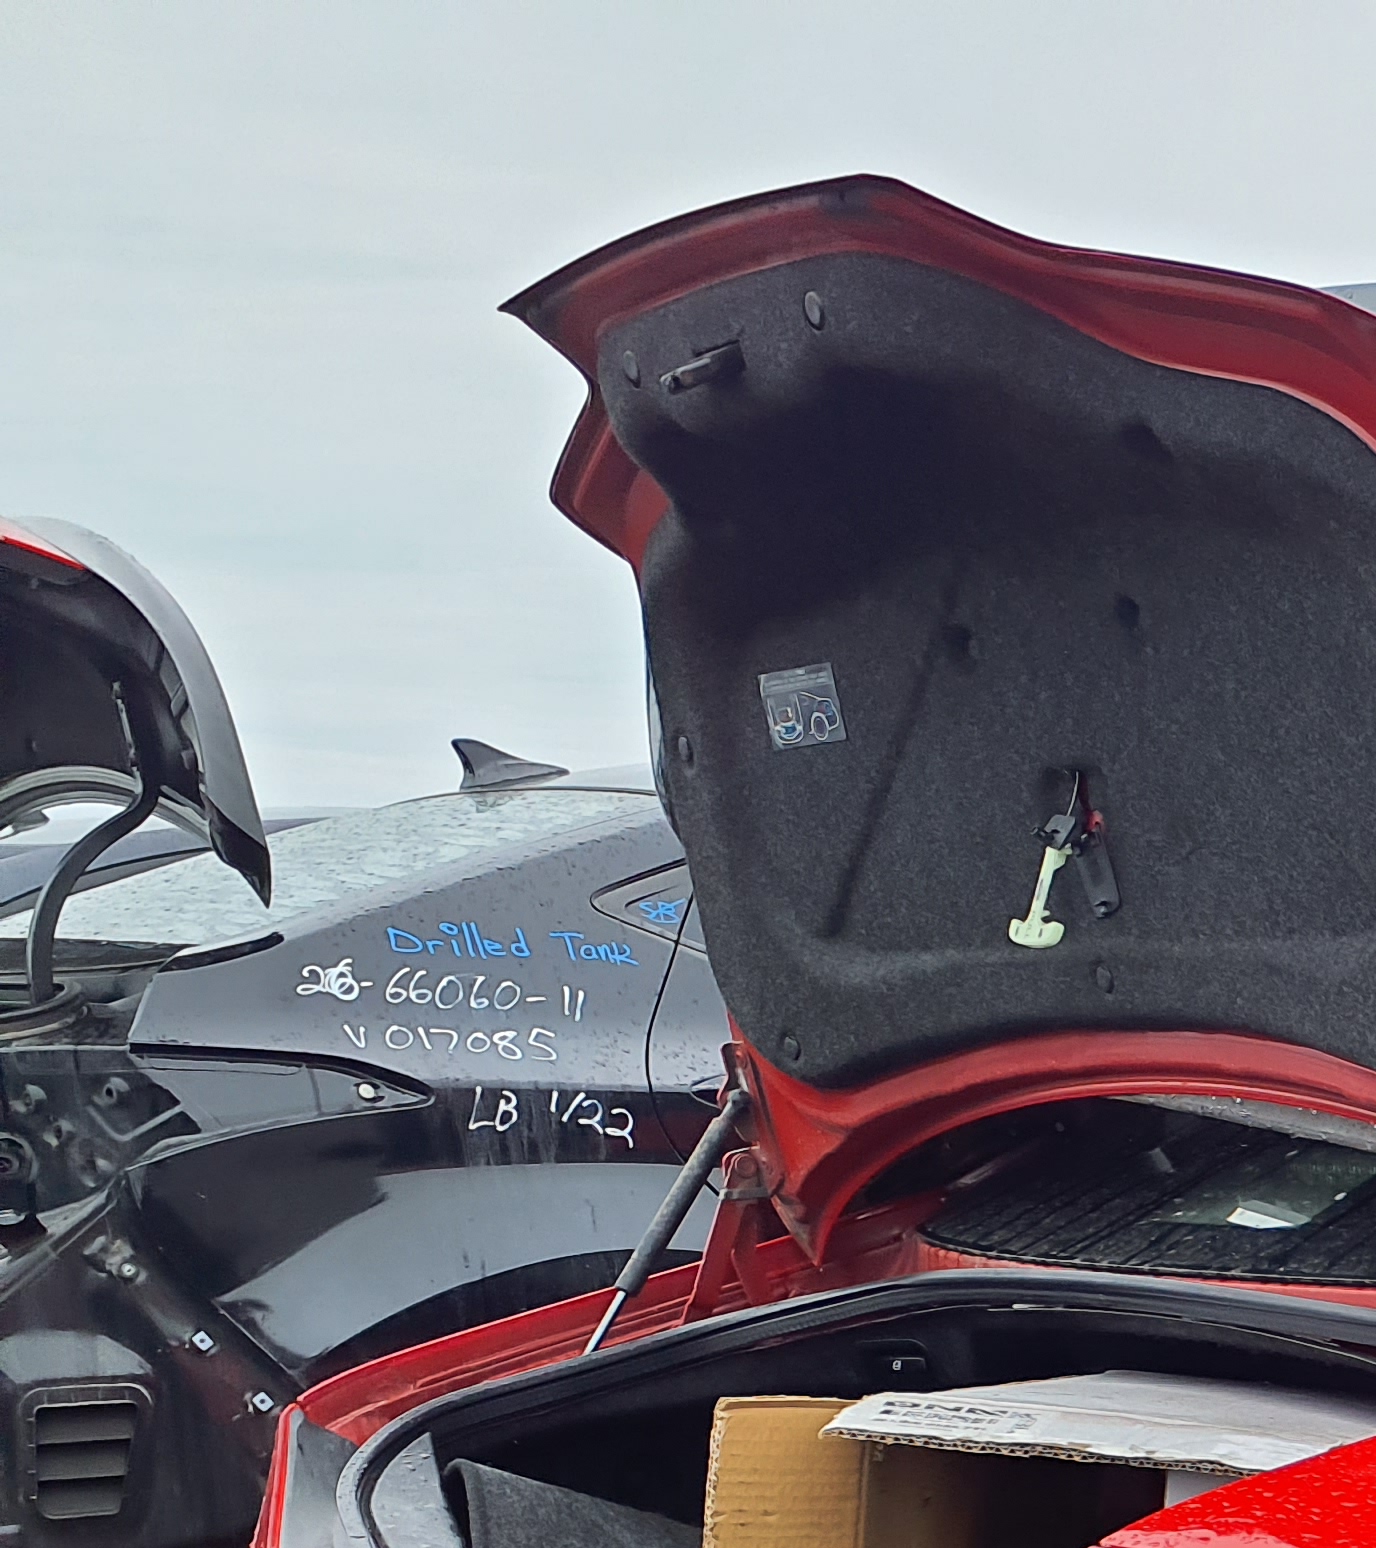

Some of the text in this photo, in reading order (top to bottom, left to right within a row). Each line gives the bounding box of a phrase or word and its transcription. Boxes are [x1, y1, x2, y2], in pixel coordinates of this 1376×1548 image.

[386, 922, 640, 966] Drilled Tank
[385, 1023, 559, 1061] 017085
[467, 1086, 635, 1149] LB 1/22
